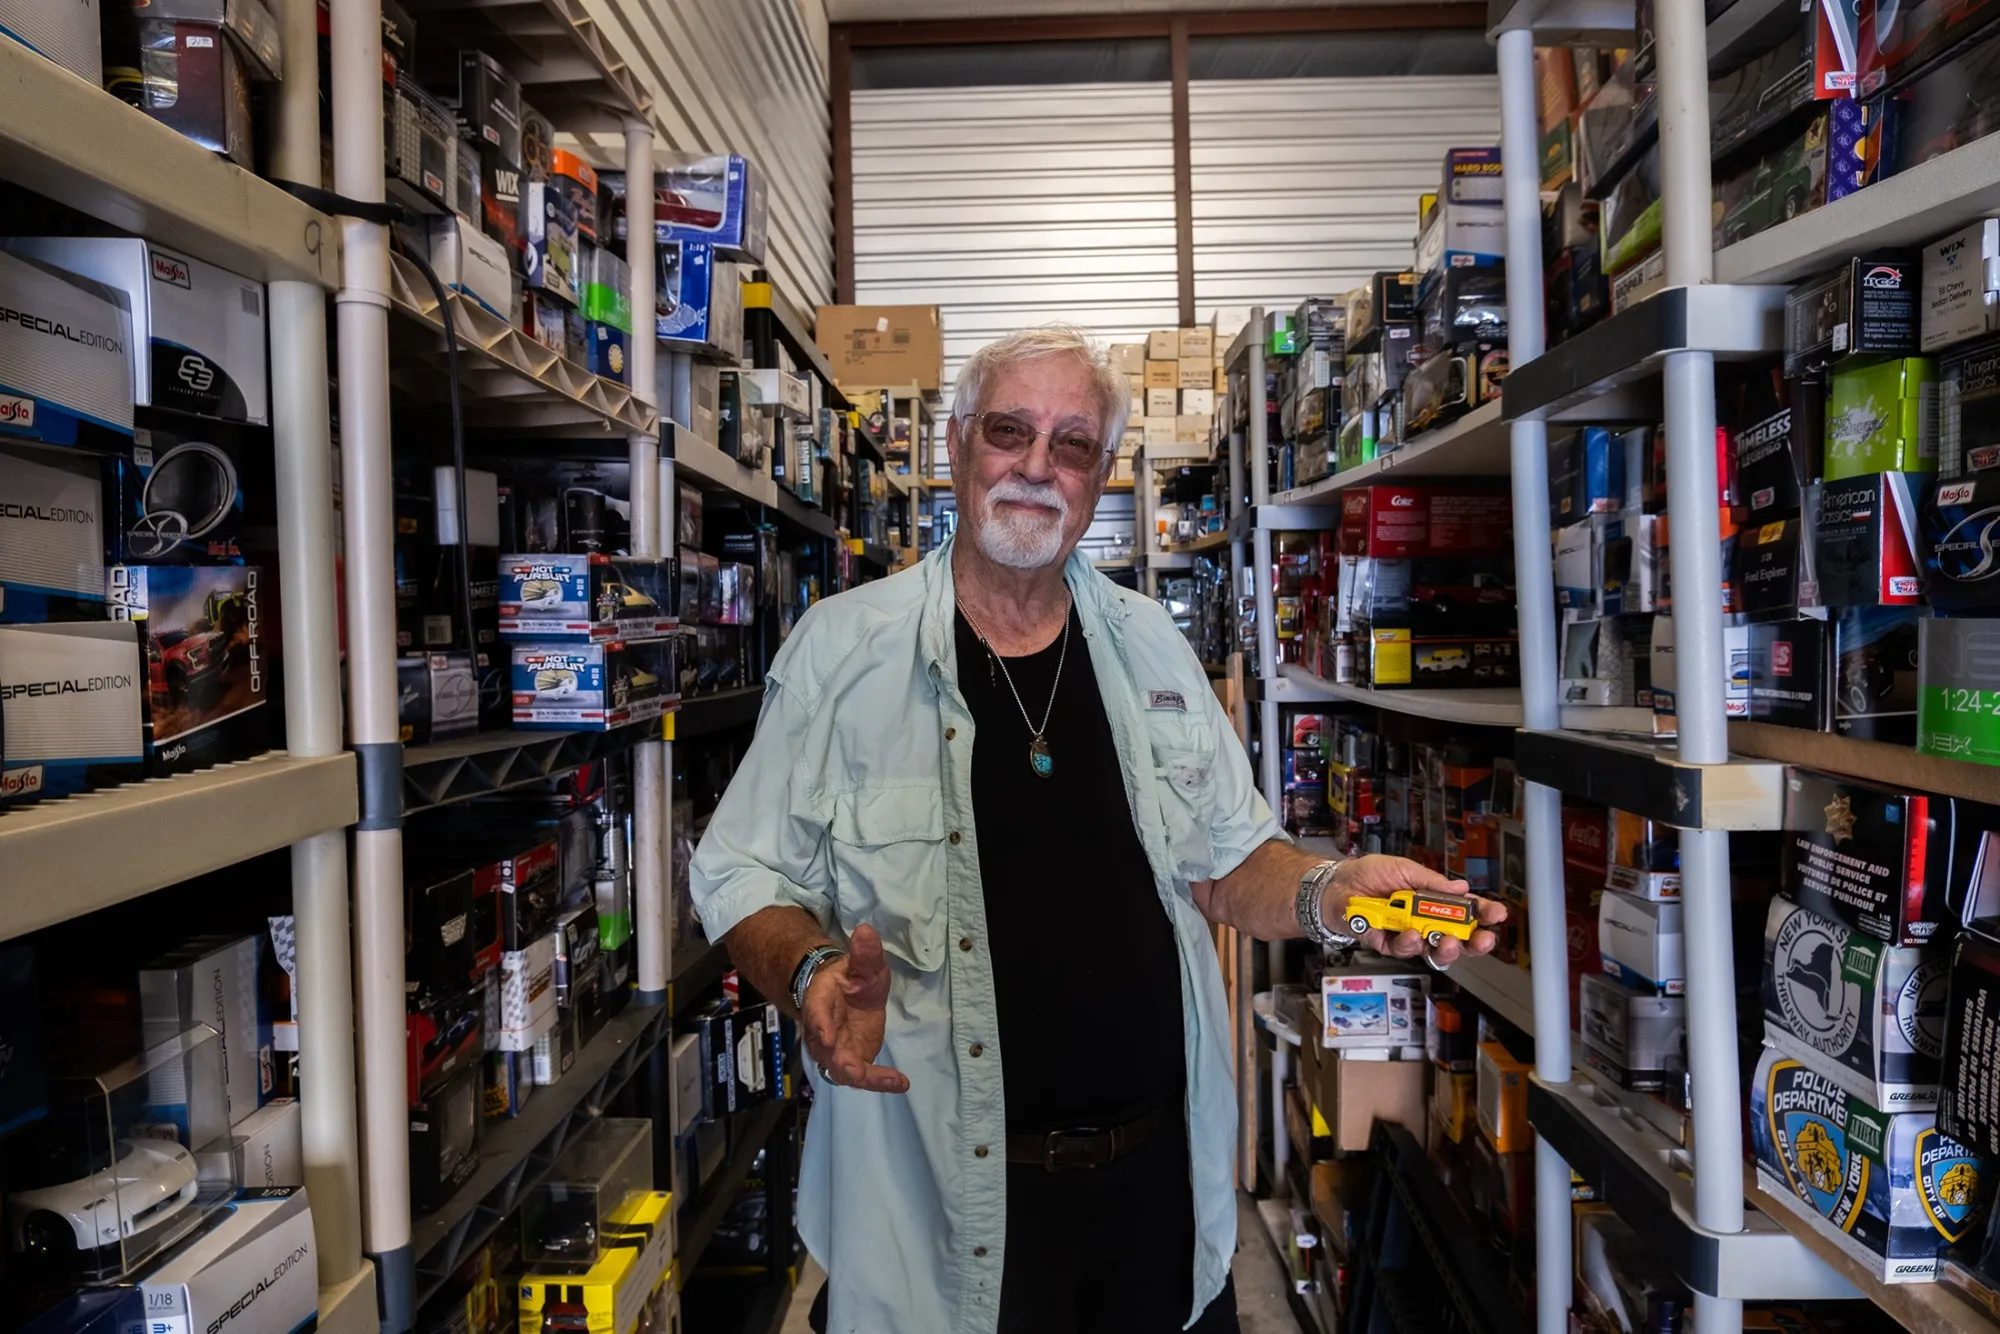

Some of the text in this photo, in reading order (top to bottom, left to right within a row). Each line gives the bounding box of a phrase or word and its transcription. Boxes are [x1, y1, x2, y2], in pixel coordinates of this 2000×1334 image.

[496, 169, 519, 189] WIX
[1940, 238, 1966, 256] WIX
[156, 260, 185, 281] Maisto
[1864, 277, 1901, 288] RC2
[1946, 280, 1965, 293] Chevy
[1949, 287, 1973, 303] Delivery
[0, 400, 29, 421] aisto
[1734, 414, 1791, 456] TIMELESS
[1391, 495, 1414, 507] Coke
[1822, 488, 1875, 508] American
[1941, 486, 1970, 504] Maisto
[1814, 507, 1853, 526] Classics
[1934, 541, 1980, 552] SPECIAL
[513, 573, 572, 583] PURSUIT
[530, 565, 554, 574] HOT
[1745, 567, 1788, 583] Ford Explorer
[247, 570, 261, 693] OFF-ROAD
[527, 662, 586, 673] PURSUIT
[544, 655, 568, 664] HOT
[1796, 838, 1890, 877] LAW ENFORCEMENT AND
[1808, 855, 1871, 884] PUBLIC SERVICE
[1797, 862, 1888, 903] VOITURES DE POLICE ET
[1803, 877, 1875, 912] SERVICE PUBLIQUE
[1780, 914, 1802, 952] NEW
[1805, 911, 1837, 935] YORK
[1848, 948, 1873, 974] ARTISAN
[1904, 969, 1928, 1000] NEW
[1777, 973, 1856, 1053] THRUWAY AUTHORITY
[1957, 998, 1974, 1121] SERVICE PUBLIQUE
[1967, 988, 1987, 1142] VOITURES DE POLICE ET
[1978, 1016, 1995, 1125] PUBLIC SERVICE
[1792, 1071, 1847, 1103] POLICE
[1774, 1091, 1848, 1127] DEPARTME
[1850, 1117, 1881, 1149] ARTISAN
[1989, 1125, 1999, 1155] AND
[1777, 1129, 1797, 1174] CITY
[1833, 1195, 1852, 1228] NEW
[1848, 1153, 1863, 1194] YORK
[1923, 1175, 1947, 1220] CITY OF
[149, 1294, 173, 1306] 1/18
[153, 1324, 173, 1333] 3+
